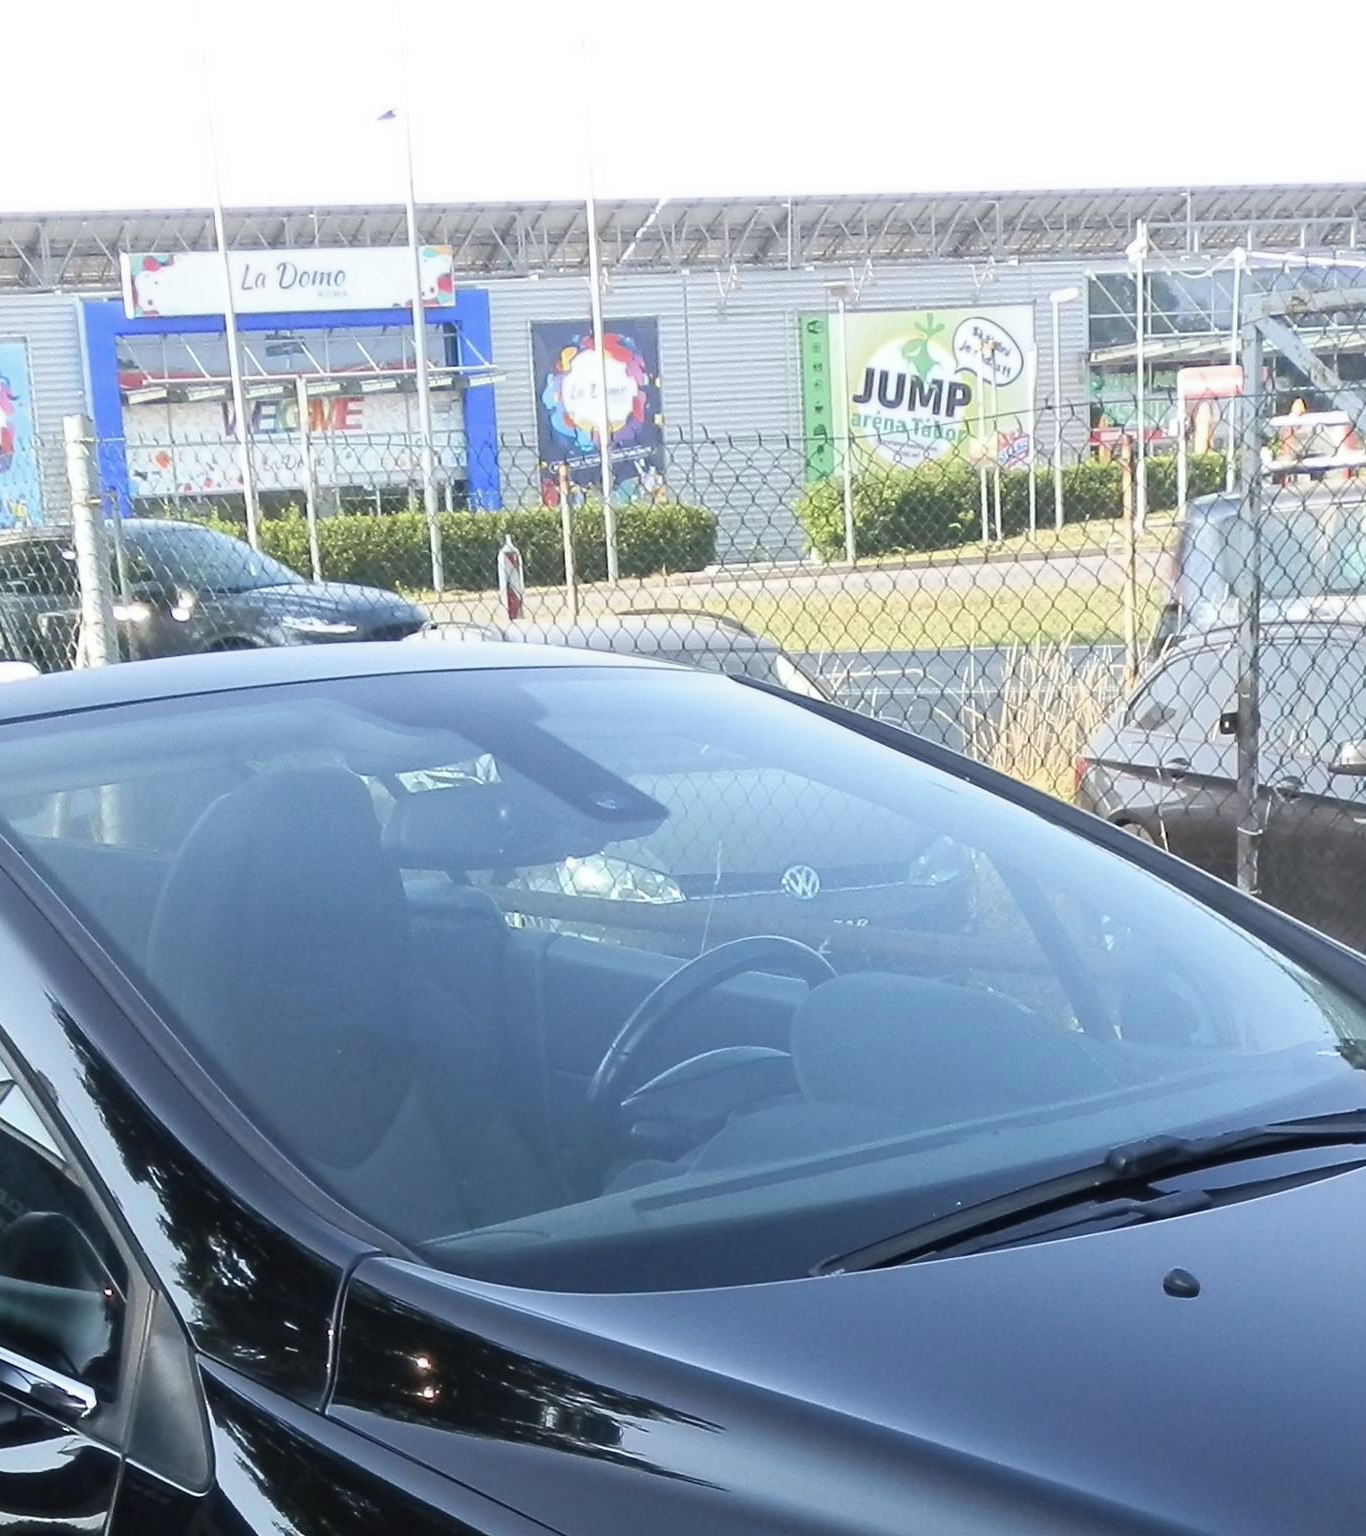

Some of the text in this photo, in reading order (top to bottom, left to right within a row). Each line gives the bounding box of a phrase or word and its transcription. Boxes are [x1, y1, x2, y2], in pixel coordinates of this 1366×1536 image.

[241, 261, 348, 291] La Domo
[852, 366, 973, 418] JUMP
[850, 409, 967, 442] aréna Tábor
